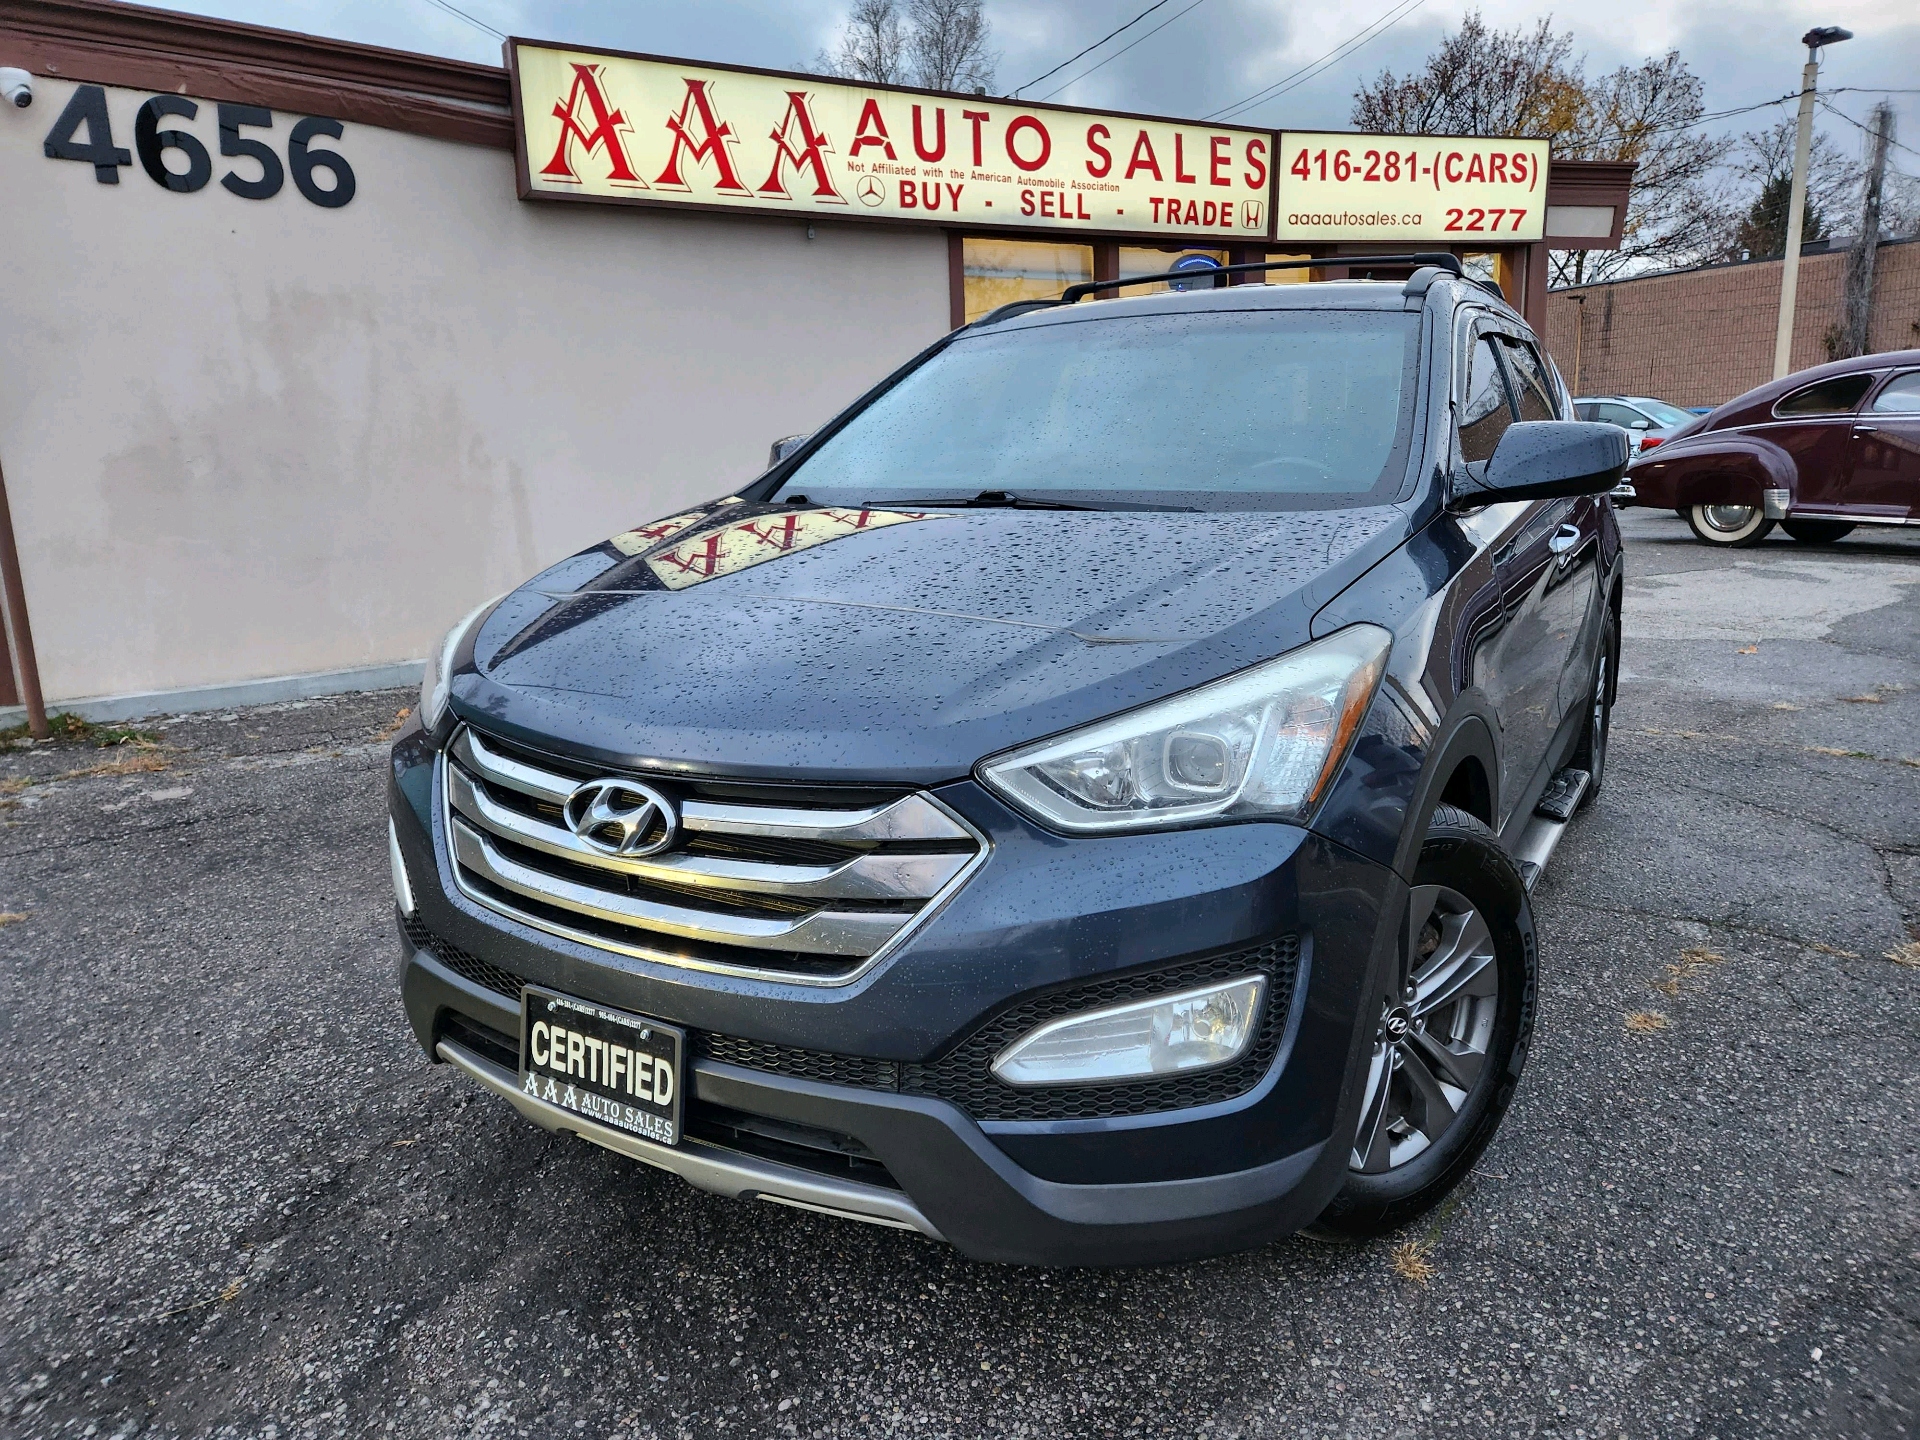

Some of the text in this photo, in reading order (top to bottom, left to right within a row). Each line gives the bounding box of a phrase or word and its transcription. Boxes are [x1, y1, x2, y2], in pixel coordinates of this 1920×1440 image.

[44, 84, 356, 208] 4656
[849, 98, 1051, 171] AUTO
[1086, 123, 1267, 189] SALES
[847, 161, 1120, 192] Not Affiliated with the American Automobile Association
[1291, 148, 1538, 192] 416-281-(CARS)
[899, 180, 1233, 228] BUY SELL TRADE
[1287, 210, 1422, 226] aaaautosales.ca
[1444, 208, 1528, 232] 2277
[531, 1020, 674, 1106] CERTIFIED
[580, 1107, 673, 1145] www.aaaautosales.ca
[581, 1092, 620, 1117] AUTO
[625, 1107, 673, 1138] SALES
